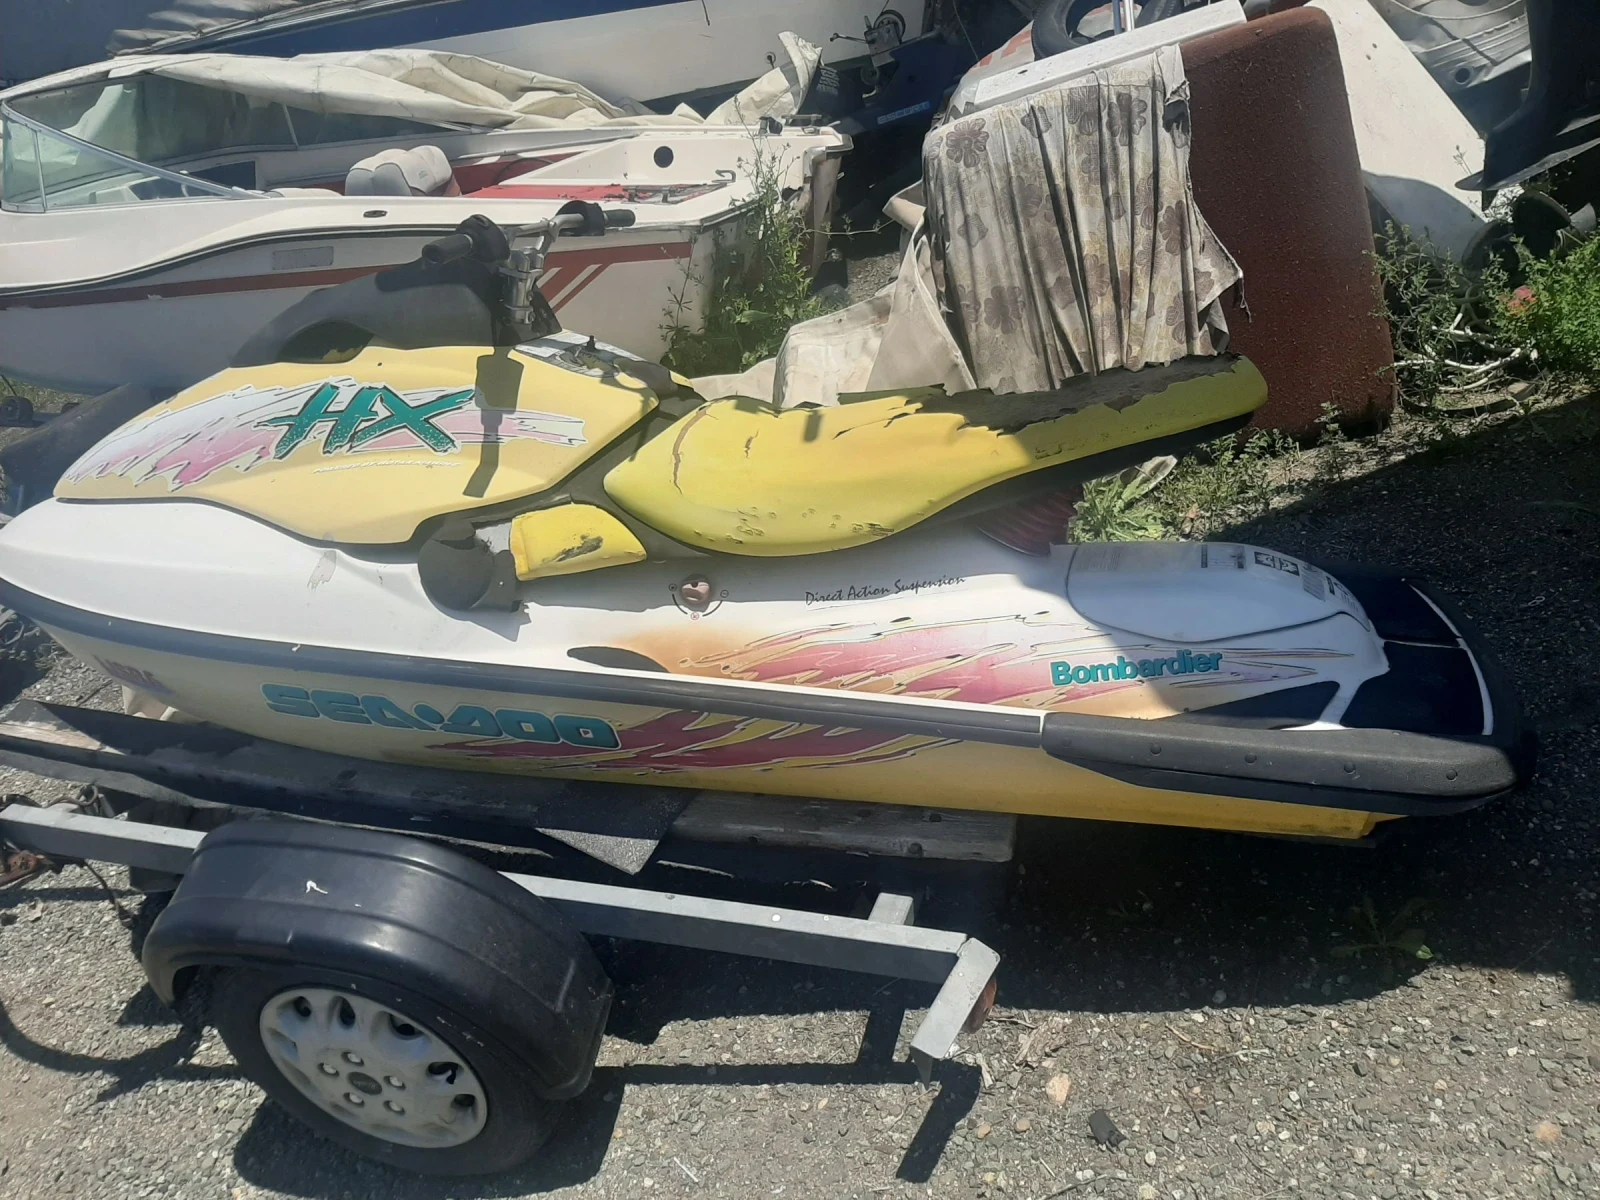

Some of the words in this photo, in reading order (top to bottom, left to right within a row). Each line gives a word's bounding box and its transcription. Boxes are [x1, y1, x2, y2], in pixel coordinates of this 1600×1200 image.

[254, 382, 476, 459] HX
[805, 587, 844, 606] Direct
[847, 585, 890, 600] Action
[894, 575, 966, 594] Suspension
[1050, 649, 1222, 686] Bombardier
